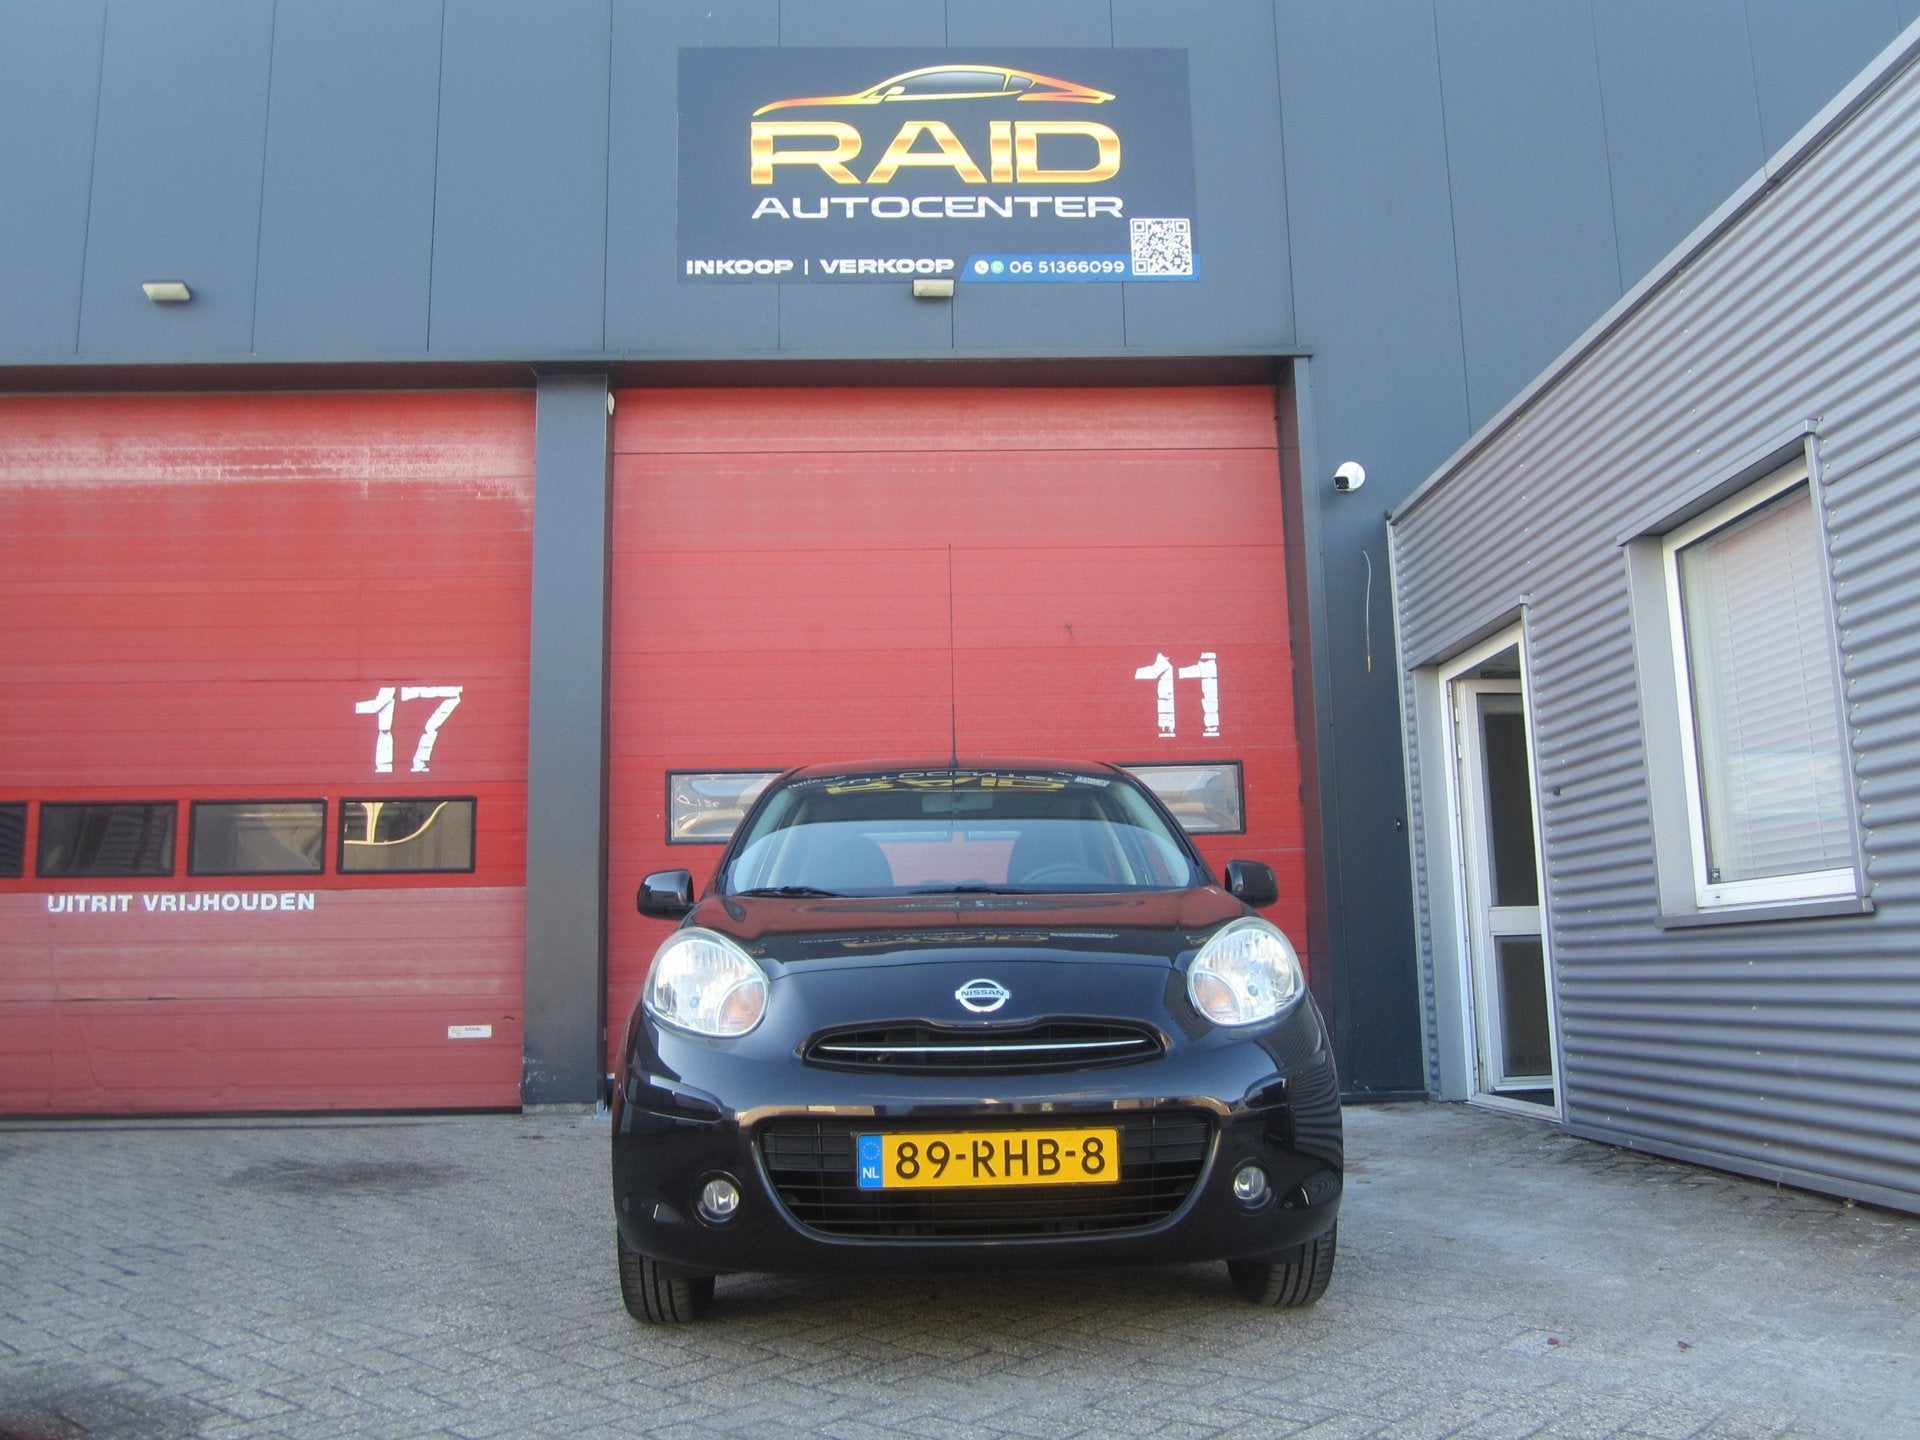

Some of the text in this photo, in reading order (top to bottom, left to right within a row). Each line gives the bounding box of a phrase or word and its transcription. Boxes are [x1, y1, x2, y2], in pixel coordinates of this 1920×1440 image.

[751, 120, 1121, 185] RAID
[751, 196, 1124, 219] AUTOCENTER
[686, 259, 794, 275] INKOOP
[819, 258, 955, 274] VERKOOP
[1009, 260, 1125, 274] 06 51366099
[1134, 652, 1220, 737] 11
[355, 686, 463, 773] 17
[48, 892, 315, 913] UITRIT VRIJHOUDEN
[961, 989, 1004, 997] NISSAN
[895, 1136, 1105, 1180] 89-RHB-8
[862, 1167, 879, 1179] NL
